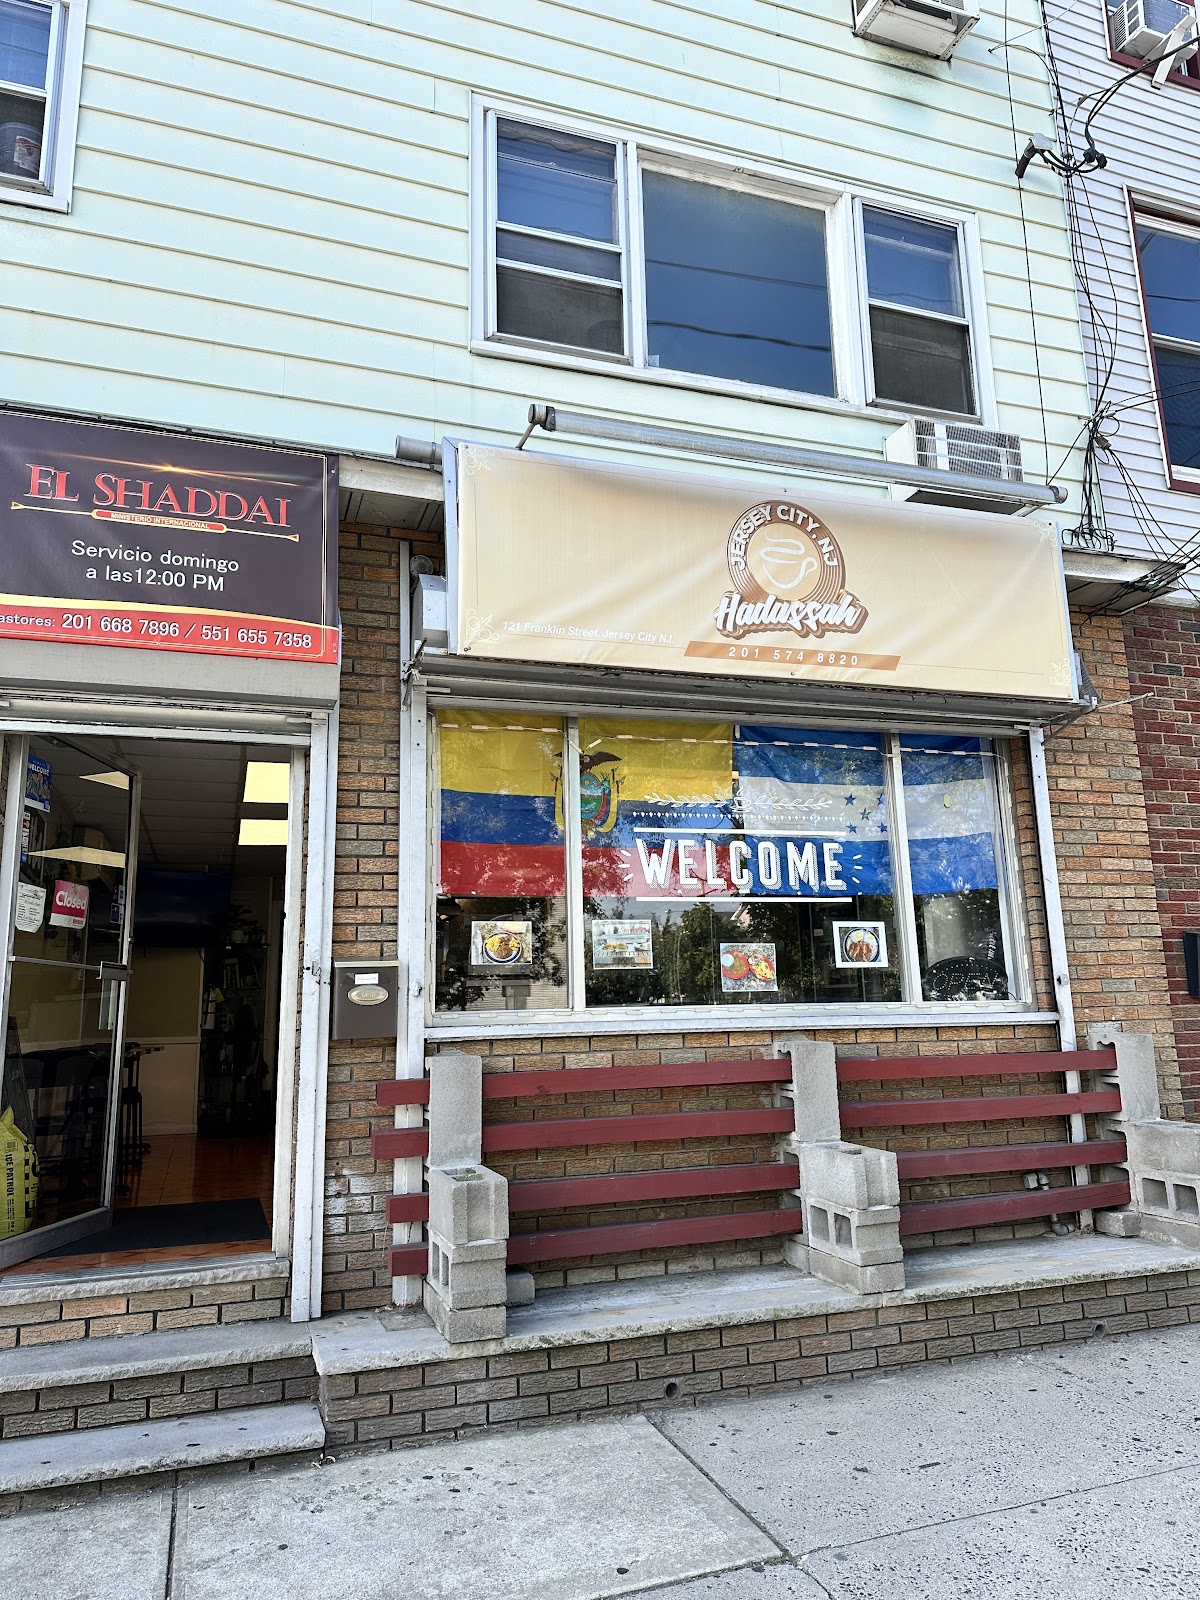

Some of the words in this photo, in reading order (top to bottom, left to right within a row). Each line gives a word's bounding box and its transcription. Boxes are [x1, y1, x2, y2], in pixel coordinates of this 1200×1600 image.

[24, 463, 80, 502] EL
[93, 472, 291, 528] SHADDAI
[110, 512, 152, 523] MINISTERIO
[153, 517, 209, 530] INTERNACIONAL
[730, 505, 773, 571] JERSEY
[817, 537, 839, 567] NJ
[71, 540, 152, 563] Servicio
[160, 550, 239, 573] domingo
[86, 568, 97, 580] a
[193, 576, 225, 592] PM
[713, 592, 864, 634] Hadassah
[61, 613, 92, 630] 201
[100, 616, 132, 633] 668
[138, 619, 180, 638] 7896
[201, 625, 230, 642] 551
[237, 629, 268, 645] 655
[274, 632, 312, 649] 7358
[502, 620, 521, 632] 121
[524, 623, 566, 636] Franklin
[602, 630, 635, 642] Jersey
[637, 631, 657, 644] City
[659, 634, 675, 644] NJ.
[728, 646, 759, 659] 201
[773, 650, 804, 662] 574
[817, 653, 858, 666] 8820
[635, 838, 847, 891] WELCOME
[55, 890, 88, 910] Closed
[5, 1153, 14, 1166] ICE
[6, 1167, 15, 1198] PATROL
